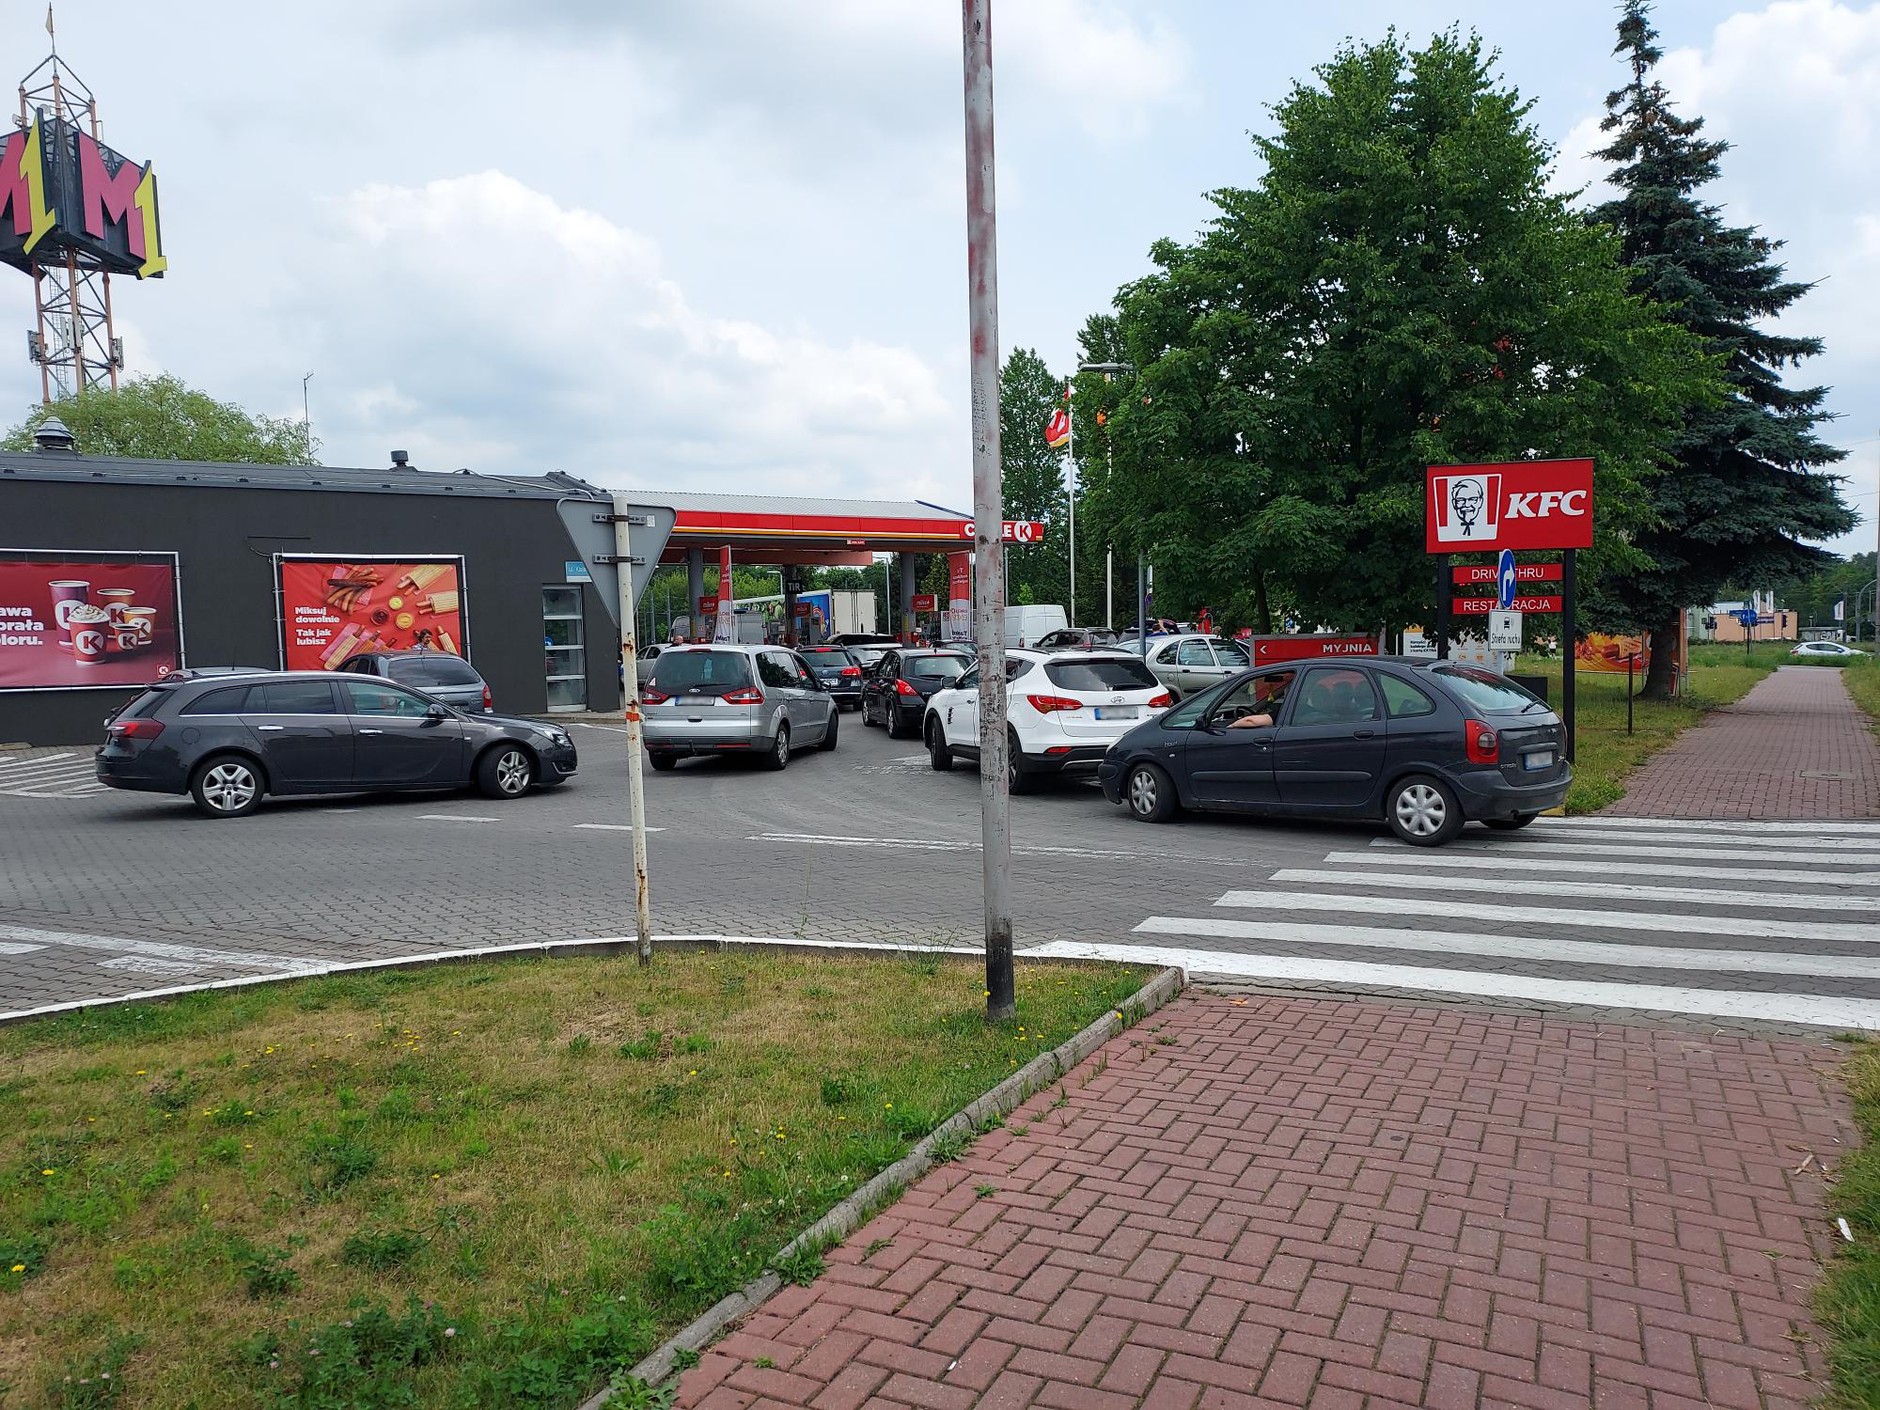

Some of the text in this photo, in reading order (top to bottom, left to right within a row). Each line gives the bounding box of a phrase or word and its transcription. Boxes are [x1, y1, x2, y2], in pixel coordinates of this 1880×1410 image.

[79, 132, 167, 280] M1
[1504, 490, 1587, 519] KFC
[1471, 567, 1544, 580] DRIV HRU
[787, 582, 801, 592] TIR
[295, 606, 326, 615] Miksuj
[1463, 599, 1551, 611] RESTRACJA
[316, 629, 331, 637] jak
[1491, 632, 1506, 644] Strefa
[0, 633, 43, 646] loru.
[83, 635, 100, 650] K
[122, 636, 136, 646] K
[1322, 643, 1372, 653] MYJNIA
